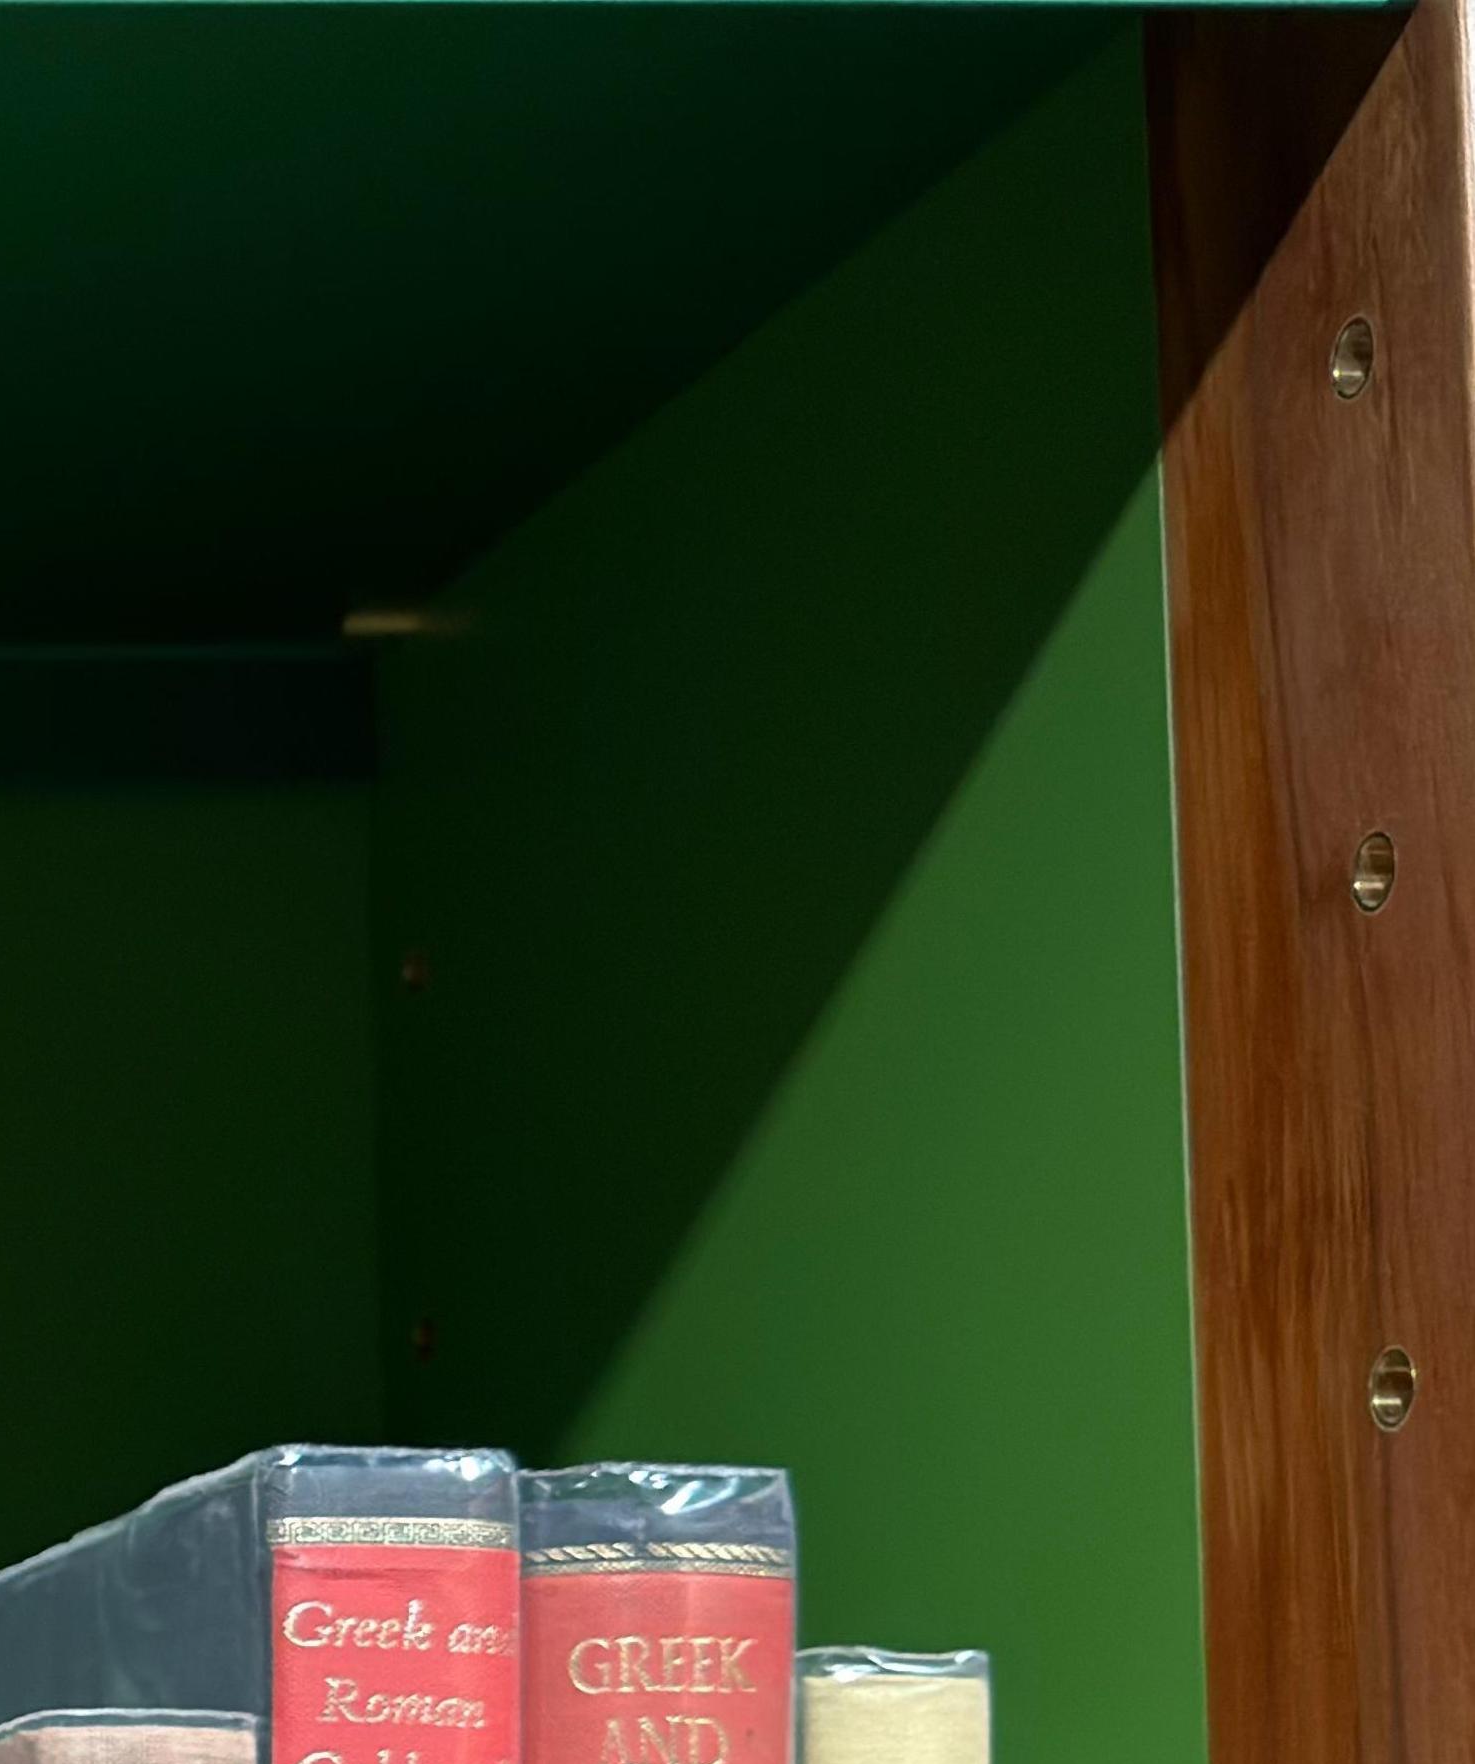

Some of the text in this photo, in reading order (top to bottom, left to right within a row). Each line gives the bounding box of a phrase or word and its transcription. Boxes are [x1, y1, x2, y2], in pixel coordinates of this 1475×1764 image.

[282, 1599, 434, 1651] Greek
[568, 1635, 759, 1696] GREEK
[316, 1677, 488, 1729] Roman
